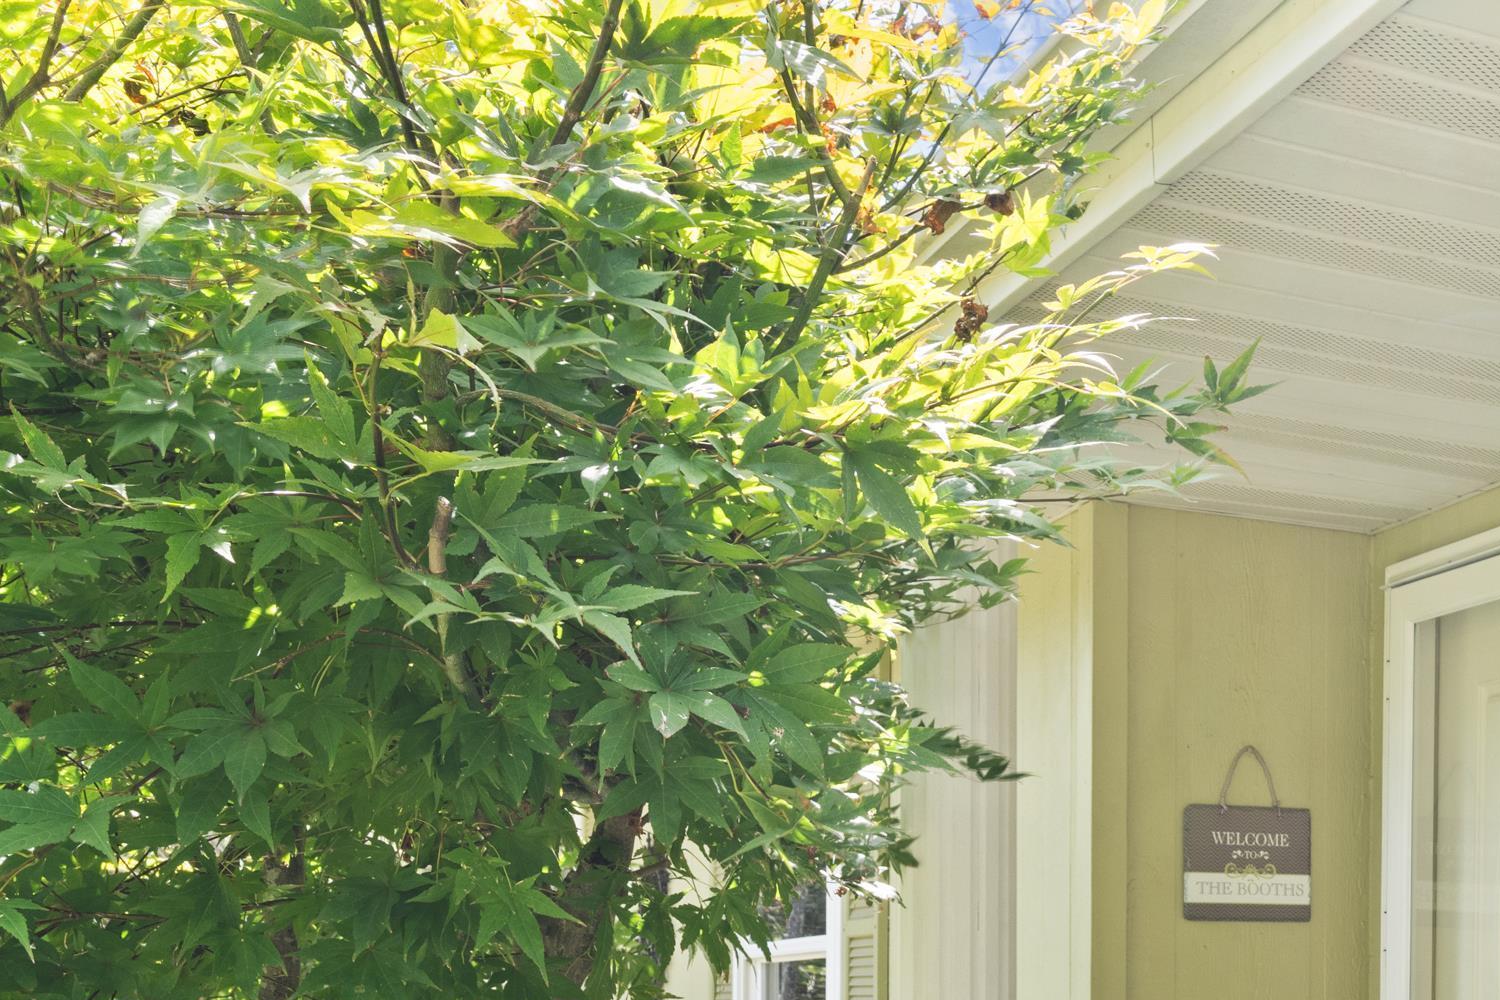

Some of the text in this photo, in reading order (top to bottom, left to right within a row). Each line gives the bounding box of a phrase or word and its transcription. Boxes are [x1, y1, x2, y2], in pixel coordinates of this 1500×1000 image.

[1212, 831, 1289, 847] WELCOME
[1244, 851, 1258, 860] TO
[1196, 881, 1304, 897] THE BOOTHS
